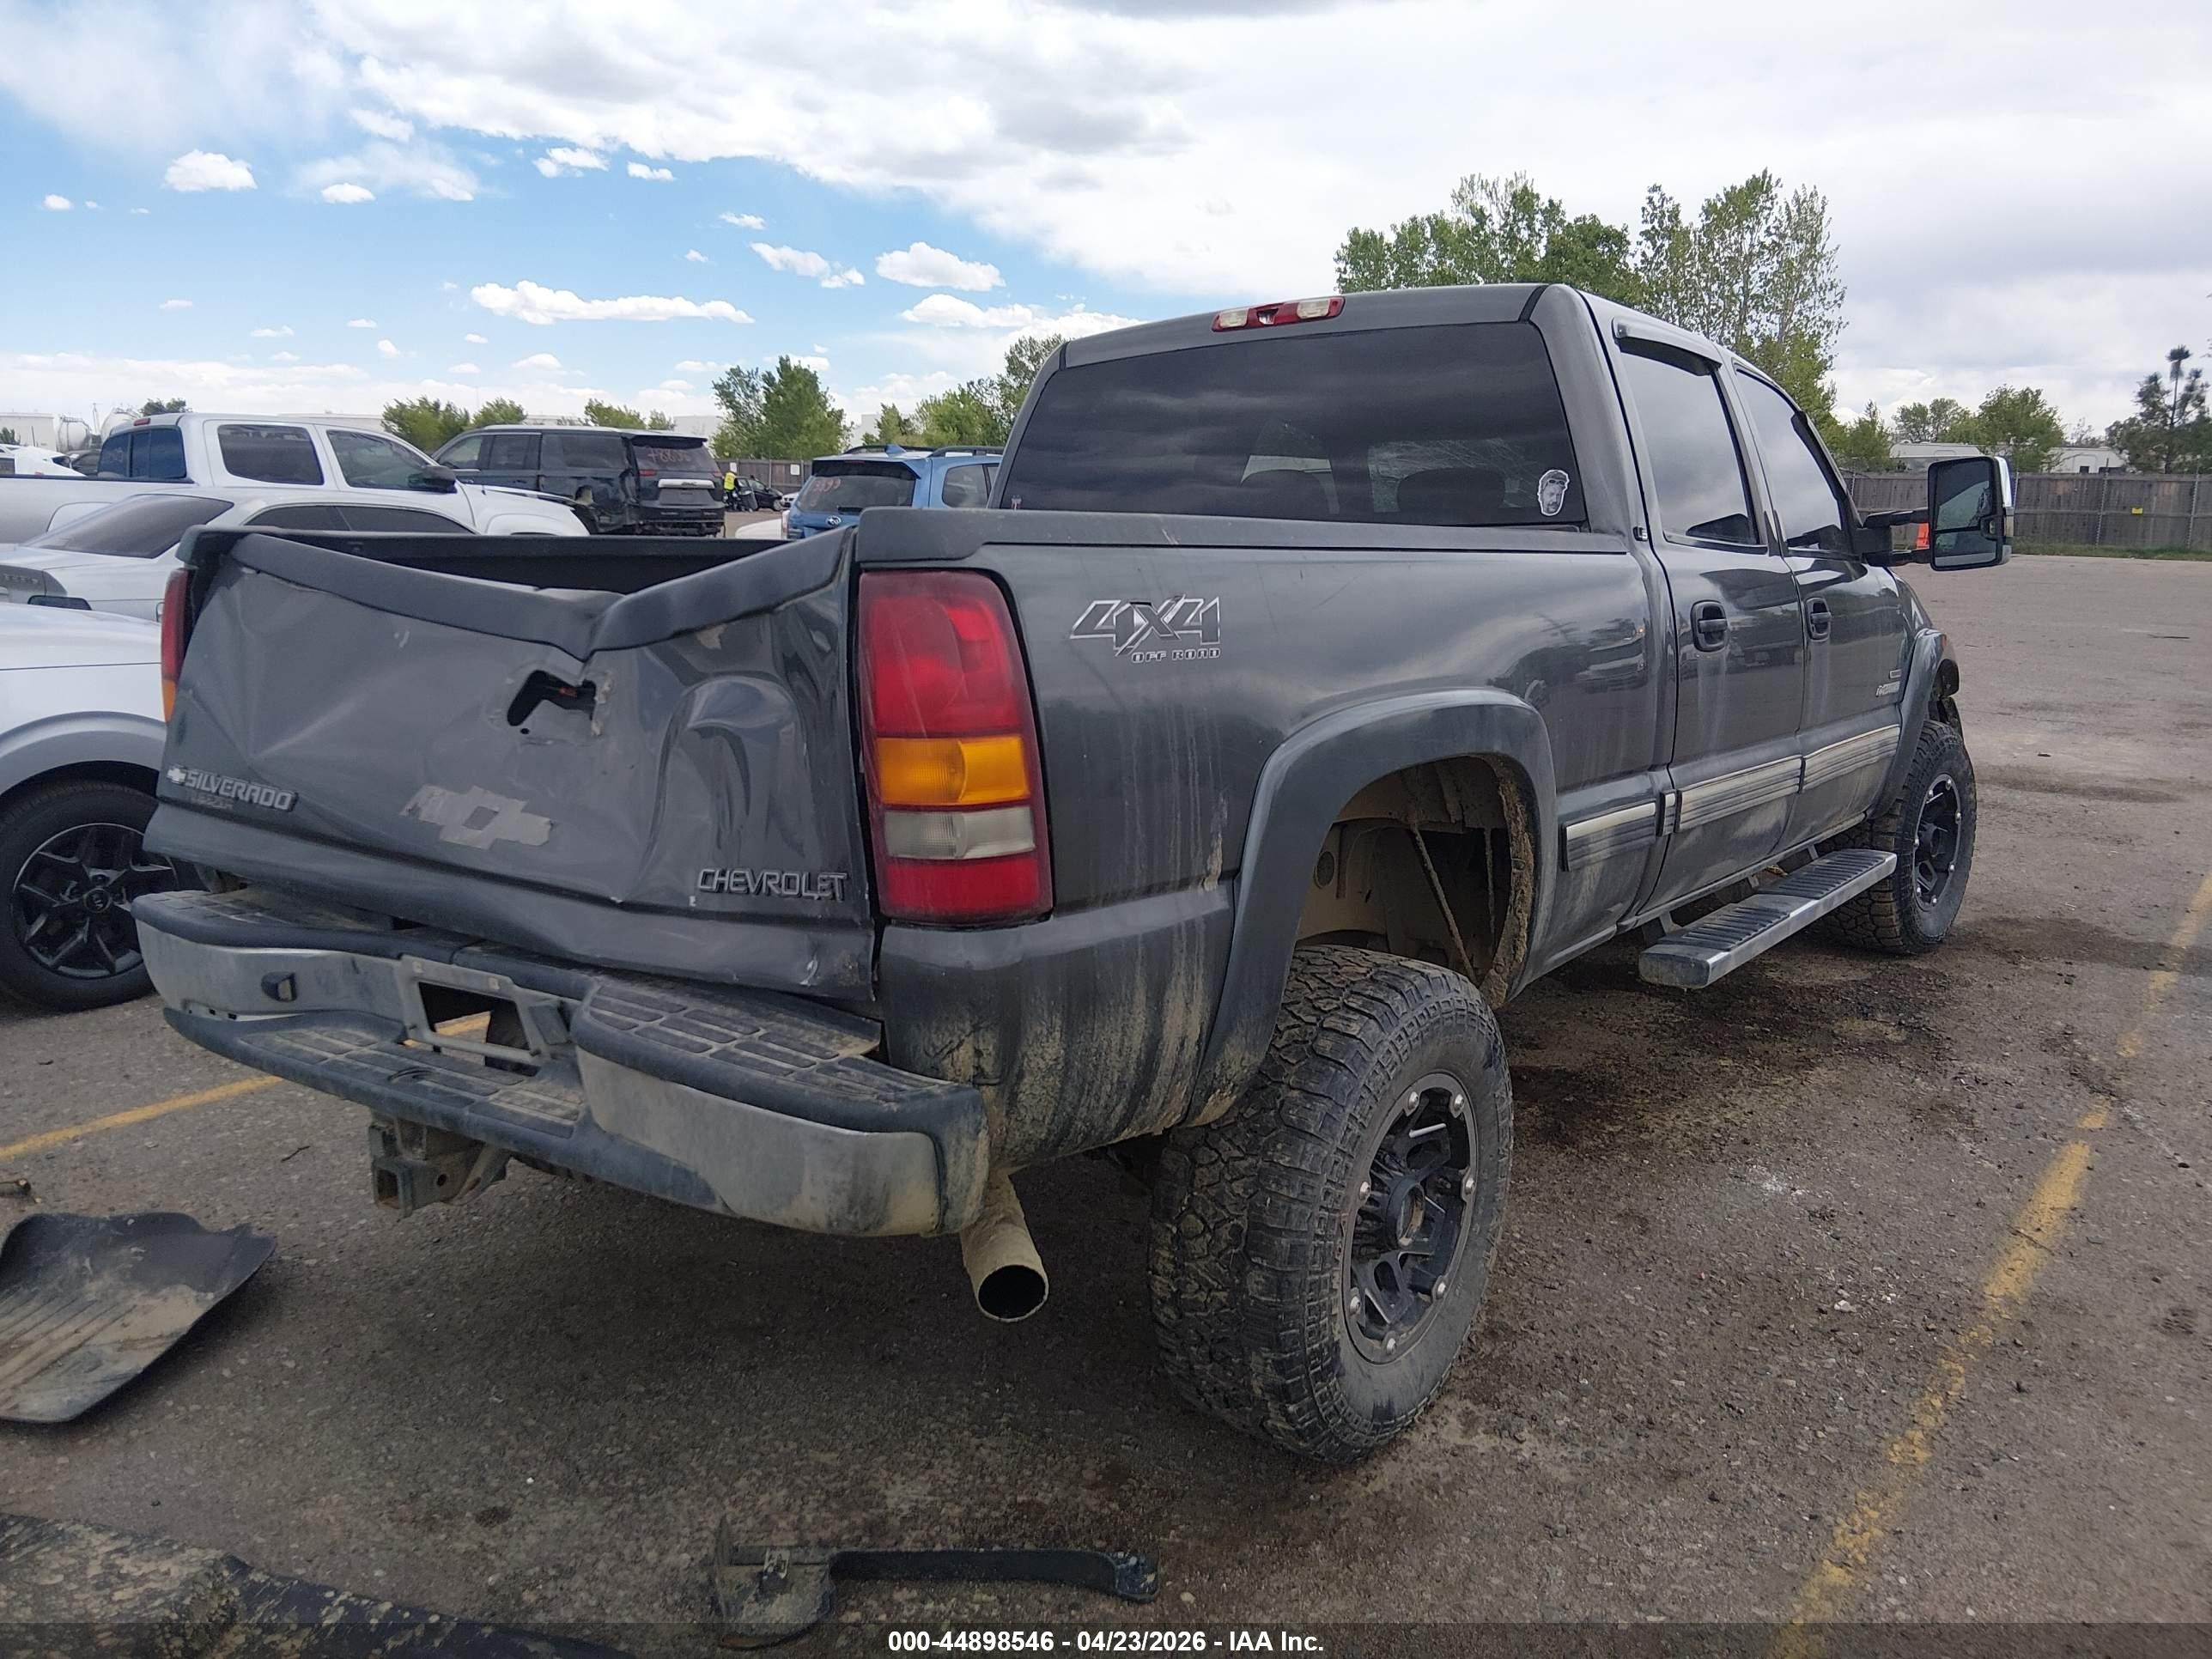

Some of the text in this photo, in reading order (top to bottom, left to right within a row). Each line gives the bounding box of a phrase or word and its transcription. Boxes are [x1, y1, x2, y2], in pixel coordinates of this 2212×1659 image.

[1131, 647, 1221, 664] OFF ROAD
[184, 769, 297, 811] SILVERADO
[696, 867, 848, 902] CHEVROLET
